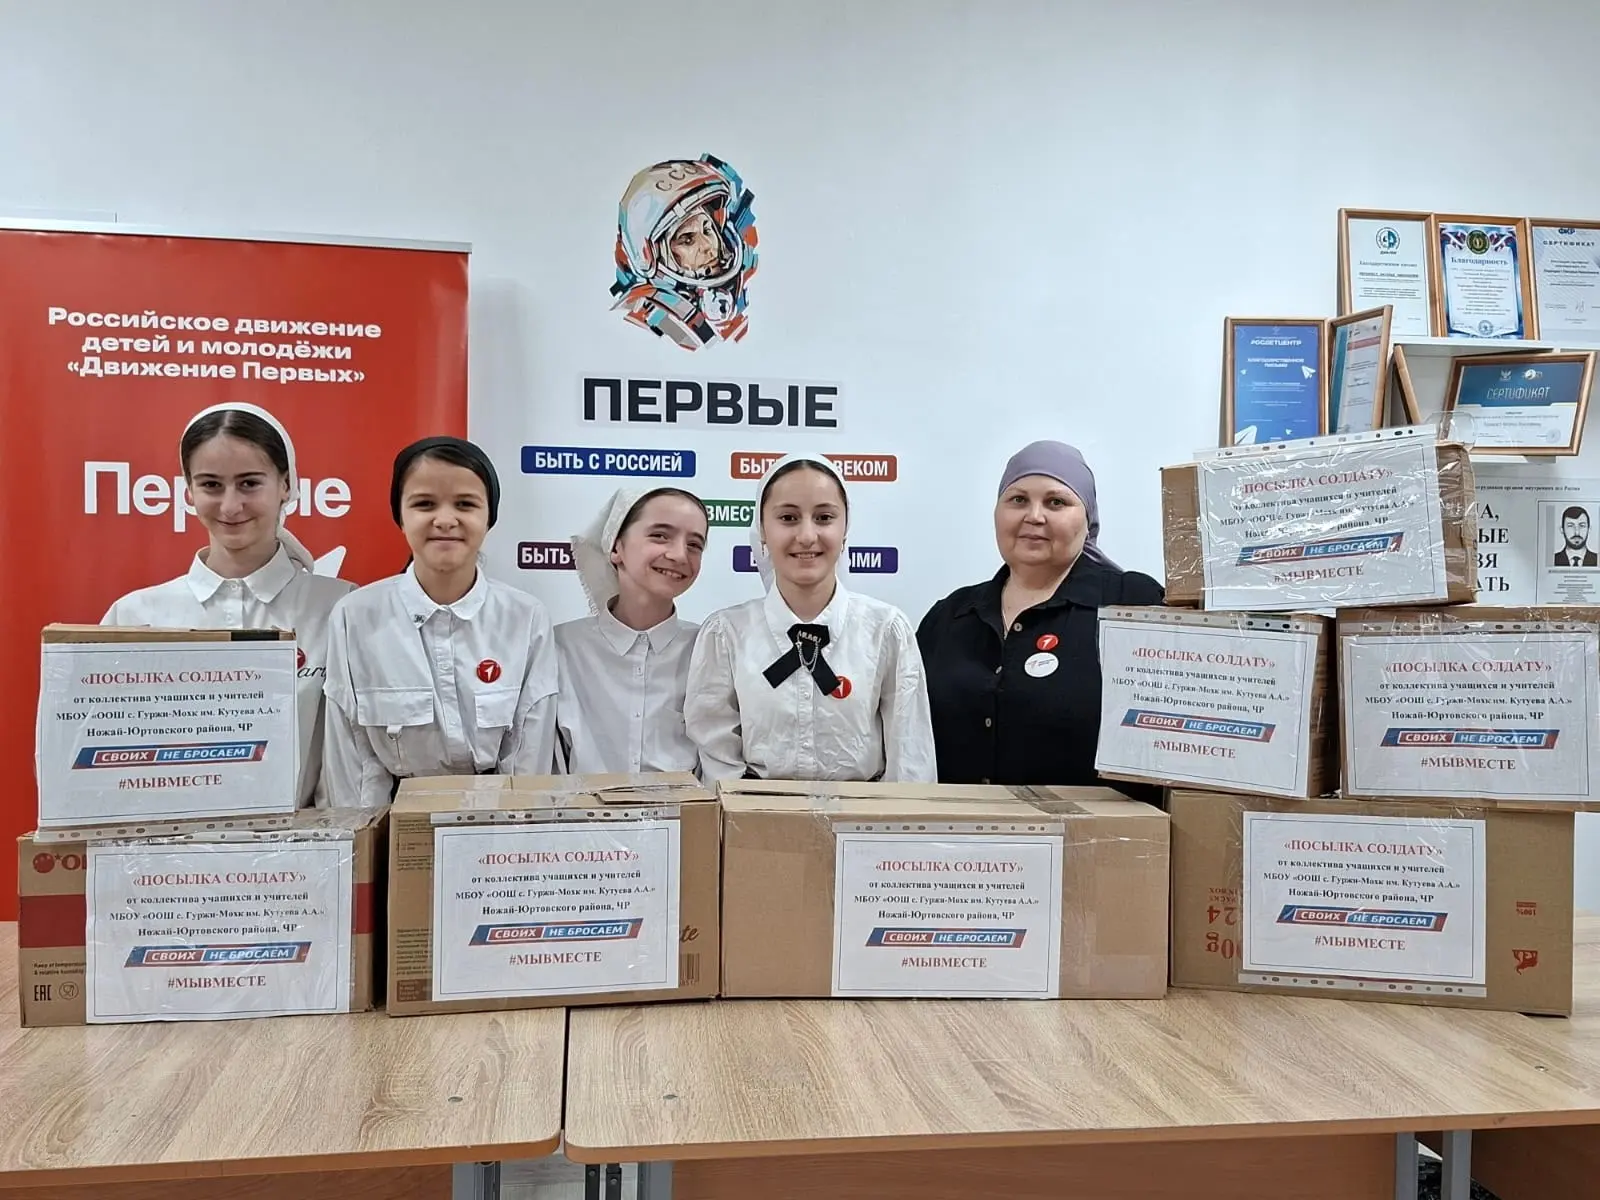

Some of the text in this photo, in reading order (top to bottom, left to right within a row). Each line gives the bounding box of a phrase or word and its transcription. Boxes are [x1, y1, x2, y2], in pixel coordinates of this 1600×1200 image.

[48, 306, 382, 339] Российское движение
[82, 334, 352, 360] детей и молодёжи
[67, 356, 365, 384] «Движение Первых»
[1486, 386, 1550, 400] СЕРТИФИКАТ
[583, 377, 838, 428] ПЕРВЫЕ
[535, 451, 682, 472] БЫТЬ С РОССИЕЙ
[740, 458, 776, 474] БЫТ
[705, 505, 756, 522] ВМЕСТ
[522, 547, 570, 565] БЫТЬ
[1309, 545, 1325, 555] НЕ
[1132, 648, 1275, 668] «ПОСЫЛКА СОЛДАТУ»
[1386, 661, 1552, 673] «ПОСЫЛКА СОЛДАТУ»
[81, 670, 262, 684] «ПОСЫЛКА СОЛДАТУ»
[88, 696, 151, 704] коллектива
[218, 691, 264, 702] учителей
[56, 712, 87, 720] МБОУ
[1252, 705, 1264, 713] ЧР
[1530, 712, 1544, 720] ЧР
[87, 723, 253, 737] Ножай-Юртовского района, ЧР
[1142, 716, 1178, 726] СВОИХ
[1205, 723, 1256, 736] БРОСАЕМ
[1406, 734, 1537, 745] СВОИХ НЕ БРОСАЕМ
[102, 748, 246, 762] СВОИХ НЕ БРОСАЕМ
[1154, 740, 1235, 758] #МЫВМЕСТЕ
[1421, 758, 1516, 770] #МЫВМЕСТЕ
[119, 774, 222, 789] #МЫВМЕСТЕ
[1284, 840, 1442, 856] «ПОСЫЛКА СОЛДАТУ»
[478, 850, 639, 865] «ПОСЫЛКА СОЛДАТУ»
[876, 861, 1023, 873] «ПОСЫЛКА СОЛДАТУ»
[1402, 866, 1444, 874] учителей
[133, 872, 306, 886] «ПОСЫЛКА СОЛДАТУ»
[485, 875, 540, 883] коллектива
[599, 870, 641, 881] учителей
[986, 882, 1025, 891] учителей
[456, 891, 483, 899] МБОУ
[482, 902, 630, 915] Ножай-Юртовского района, ЧР
[878, 910, 964, 920] Ножай-Юртовского
[966, 912, 1000, 921] района,
[1207, 905, 1238, 926] 24
[1301, 911, 1426, 925] СВОИХ НЕ БРОСАЕМ
[283, 924, 297, 932] ЧР
[495, 924, 623, 938] СВОИХ НЕ БРОСАЕМ
[939, 934, 953, 942] НЕ
[955, 934, 1007, 944] БРОСАЕМ
[1315, 936, 1405, 950] #МЫВМЕСТЕ
[152, 948, 289, 961] СВОИХ НЕ БРОСАЕМ
[510, 952, 602, 965] #МЫВМЕСТЕ
[902, 957, 986, 968] #МЫВМЕСТЕ
[168, 976, 266, 988] #МЫВМЕСТЕ
